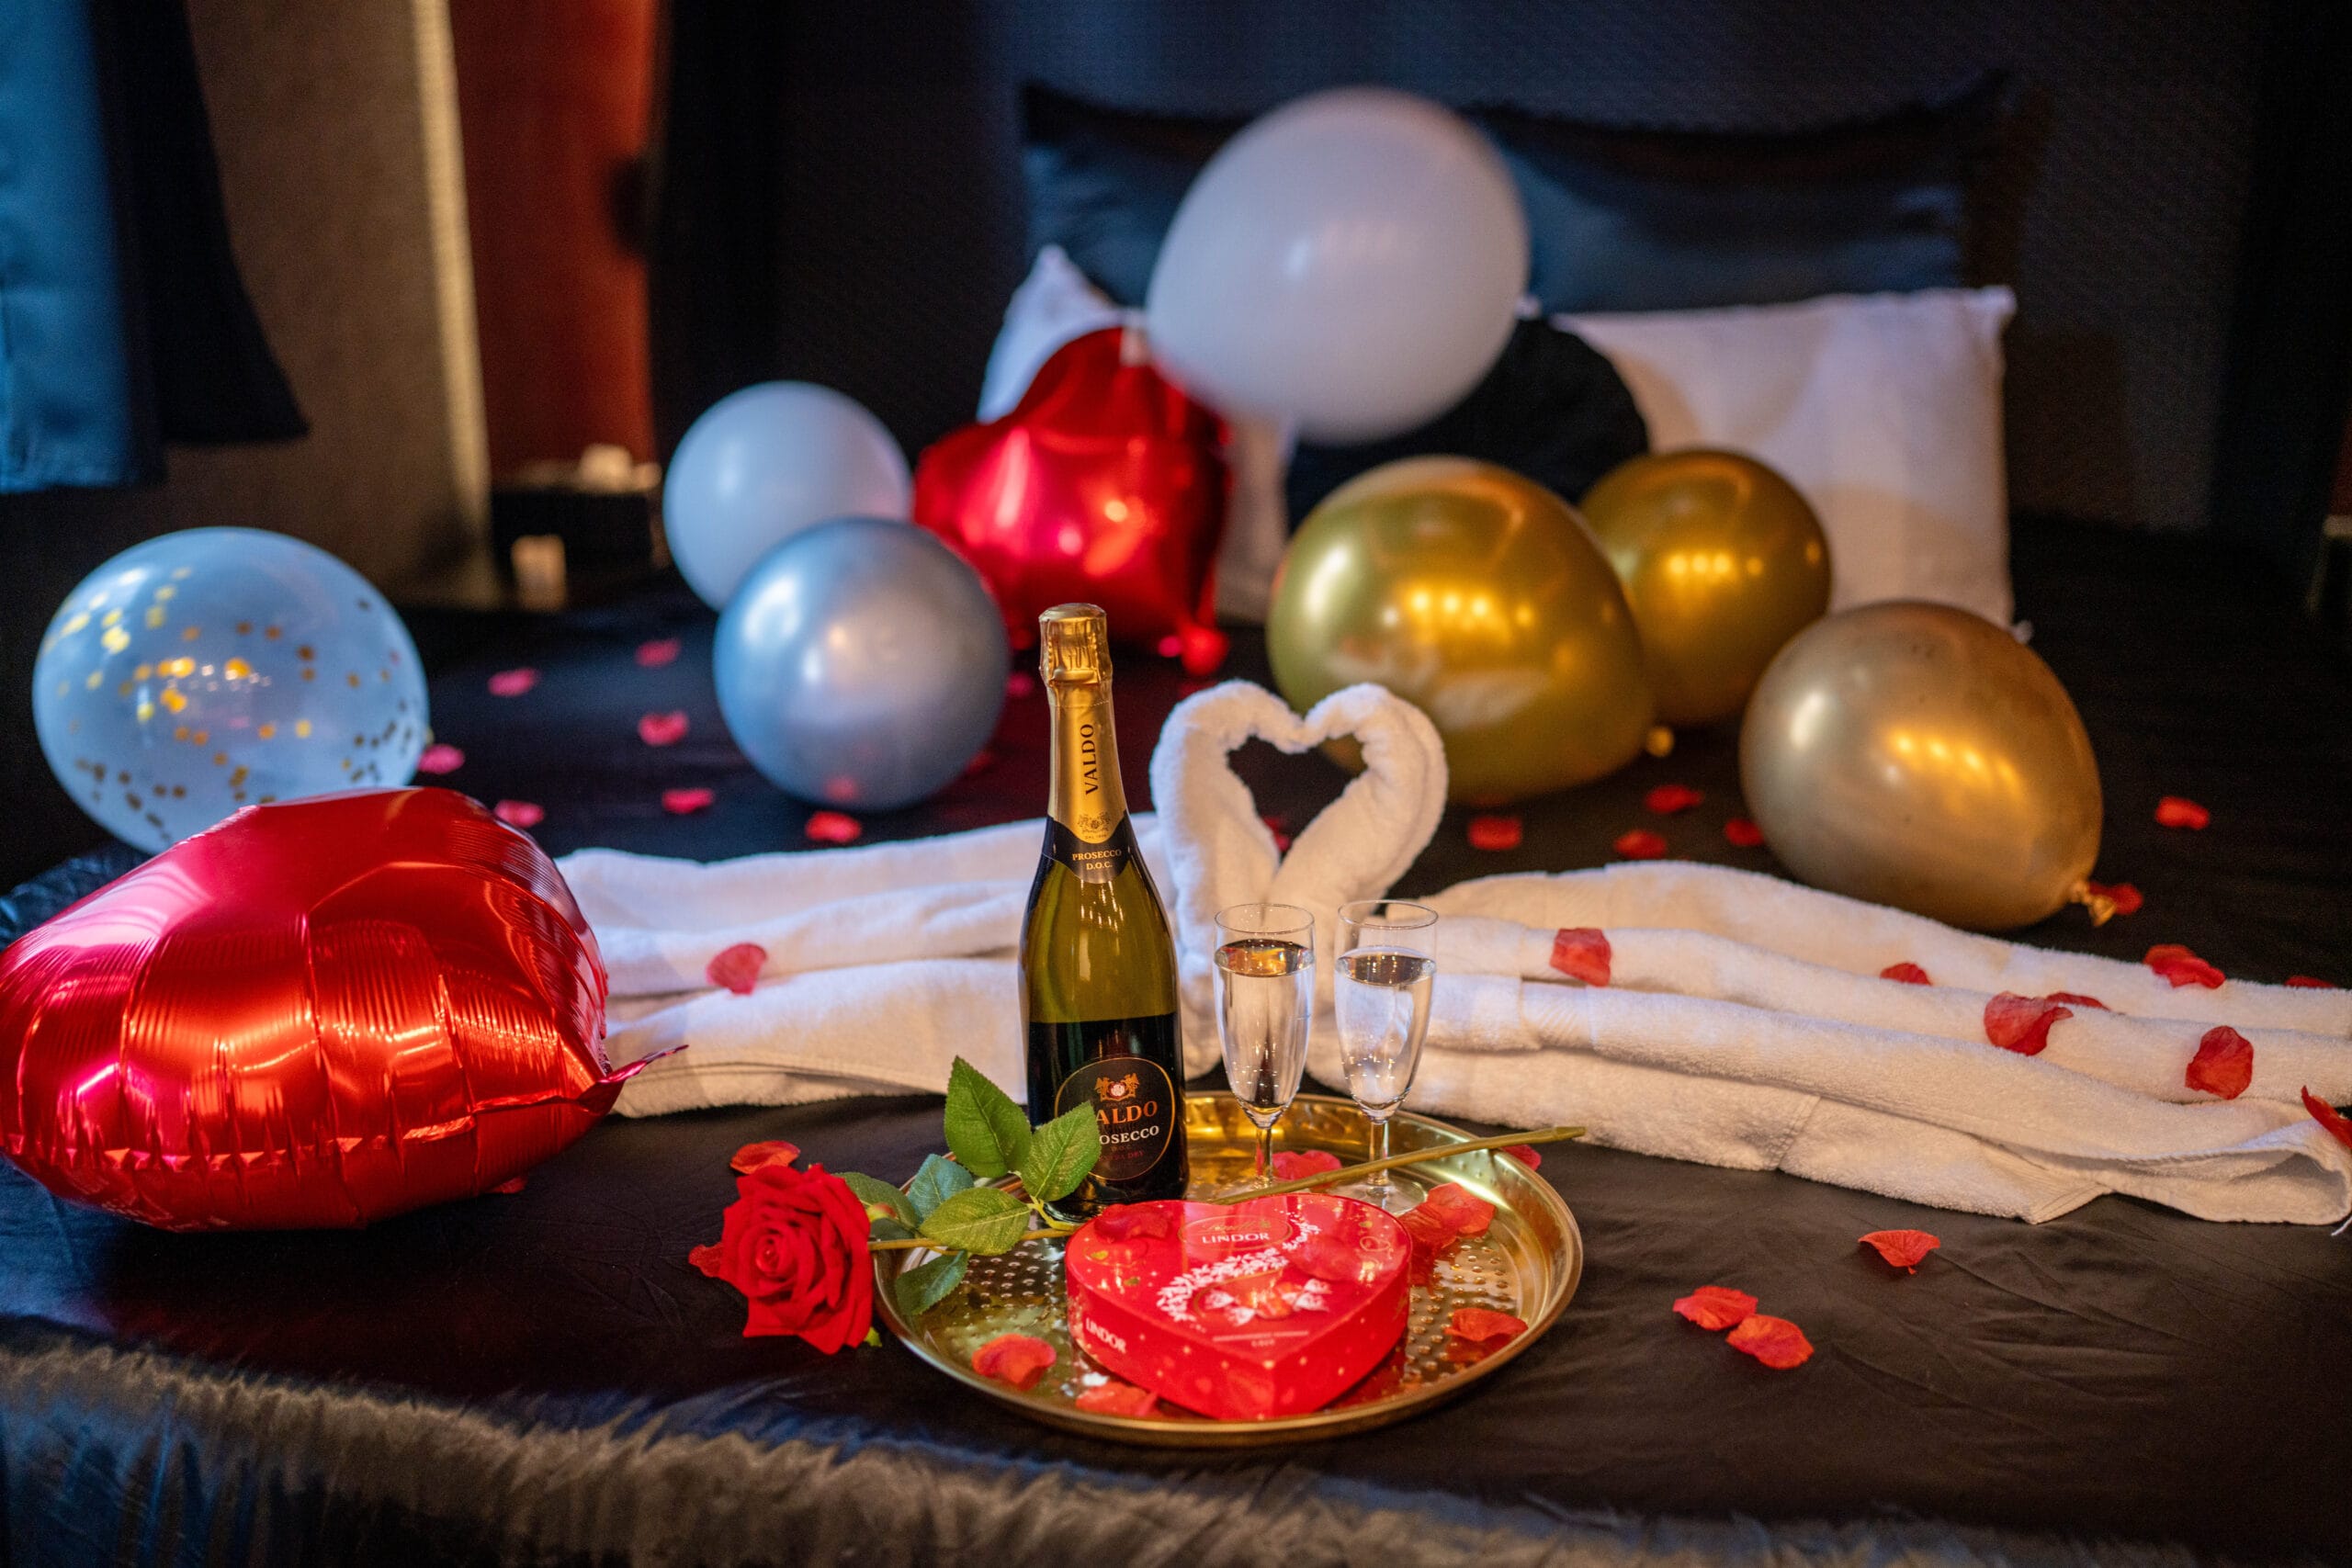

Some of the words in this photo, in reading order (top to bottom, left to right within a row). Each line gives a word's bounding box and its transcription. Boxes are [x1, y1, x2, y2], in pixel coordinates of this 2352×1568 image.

[1080, 723, 1099, 795] VALDO
[1072, 850, 1122, 861] PROSECCO
[1086, 862, 1113, 871] D.O.C.
[1096, 1100, 1159, 1125] ALDO
[1099, 1125, 1159, 1145] OSECCO
[1202, 1232, 1271, 1244] LINDOR
[1085, 1317, 1126, 1354] LINDOR
